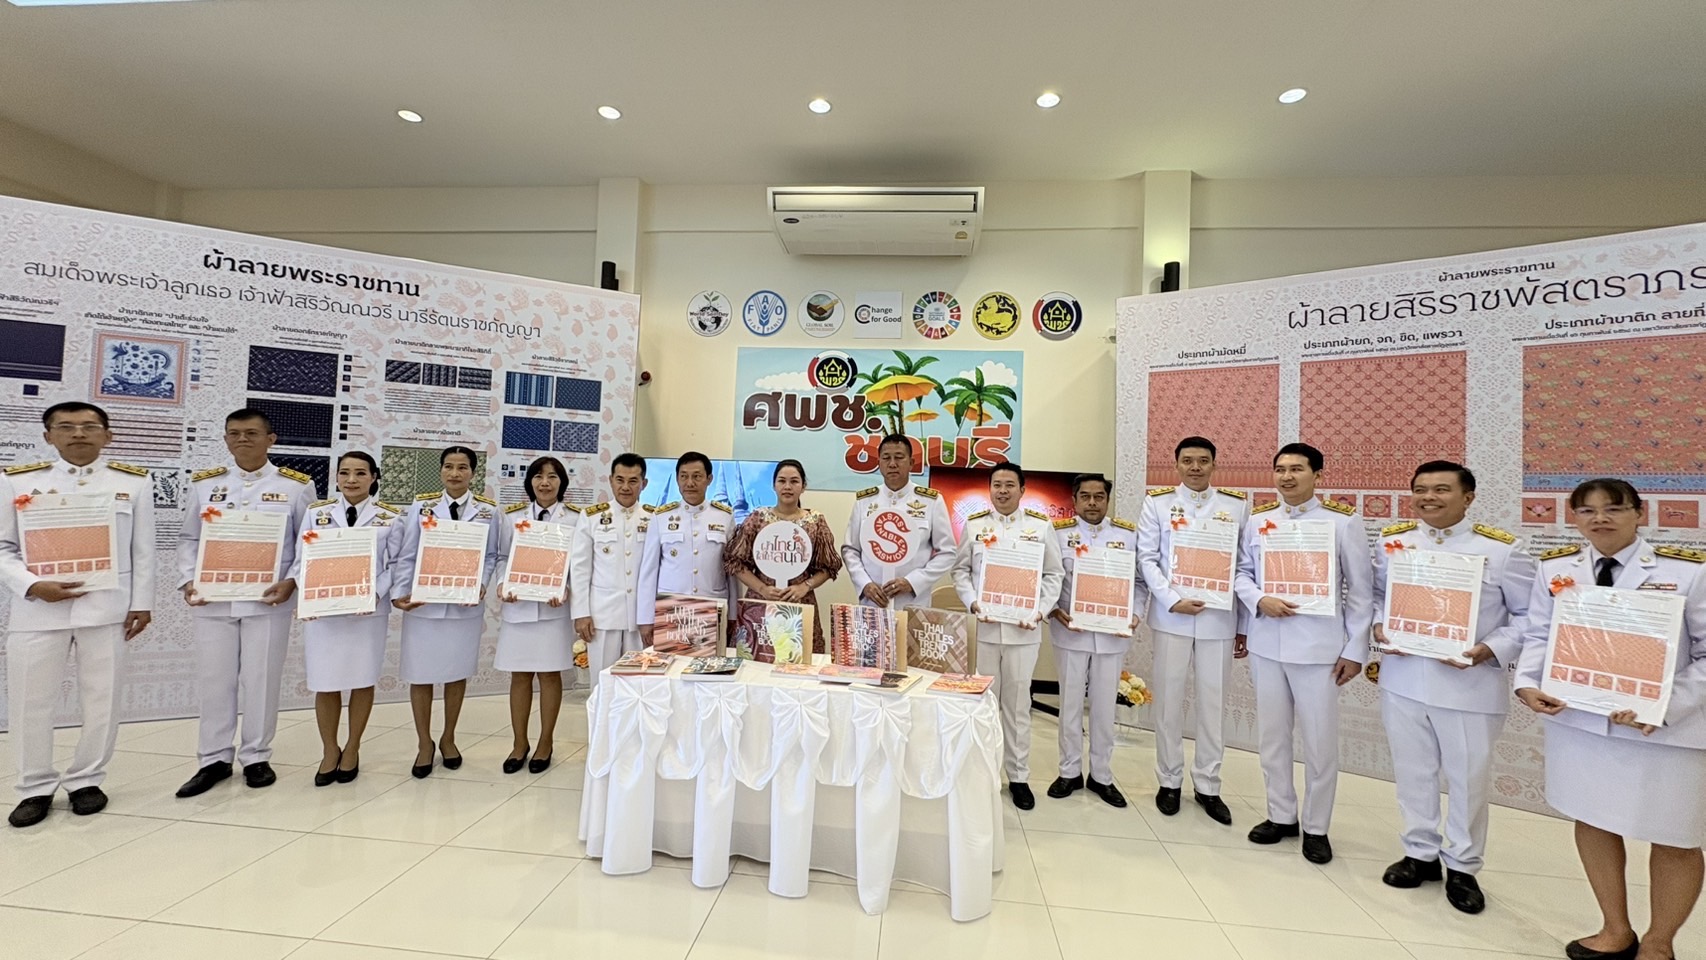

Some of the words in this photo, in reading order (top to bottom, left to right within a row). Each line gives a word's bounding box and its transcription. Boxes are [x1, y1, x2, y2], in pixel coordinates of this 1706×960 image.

[203, 249, 420, 297] ผ้าลายพระราชทาน
[1438, 260, 1555, 282] ผ้าลายพระราชทาน
[24, 261, 231, 300] สมเด็จพระเจ้าลูกเธอ
[239, 285, 392, 319] เจ้าฟ้าสิริวัณณวรี
[398, 308, 541, 340] นารีรัตนราชกัญญา
[871, 315, 881, 323] for
[882, 315, 902, 323] Good
[1545, 311, 1656, 330] ประเภทผ้าบาติก
[1304, 336, 1373, 350] ประเภทผ้ายก,
[1423, 329, 1463, 340] แพรวา
[1178, 343, 1247, 359] ประเภทผ้ามัดหมี่
[743, 391, 883, 431] ศพช.
[875, 512, 906, 546] SUSTAINABLE
[873, 546, 906, 561] FASHION
[913, 628, 954, 645] TEXTILES
[922, 621, 944, 634] THAI
[919, 639, 948, 652] TREND
[920, 647, 945, 661] BOOK
